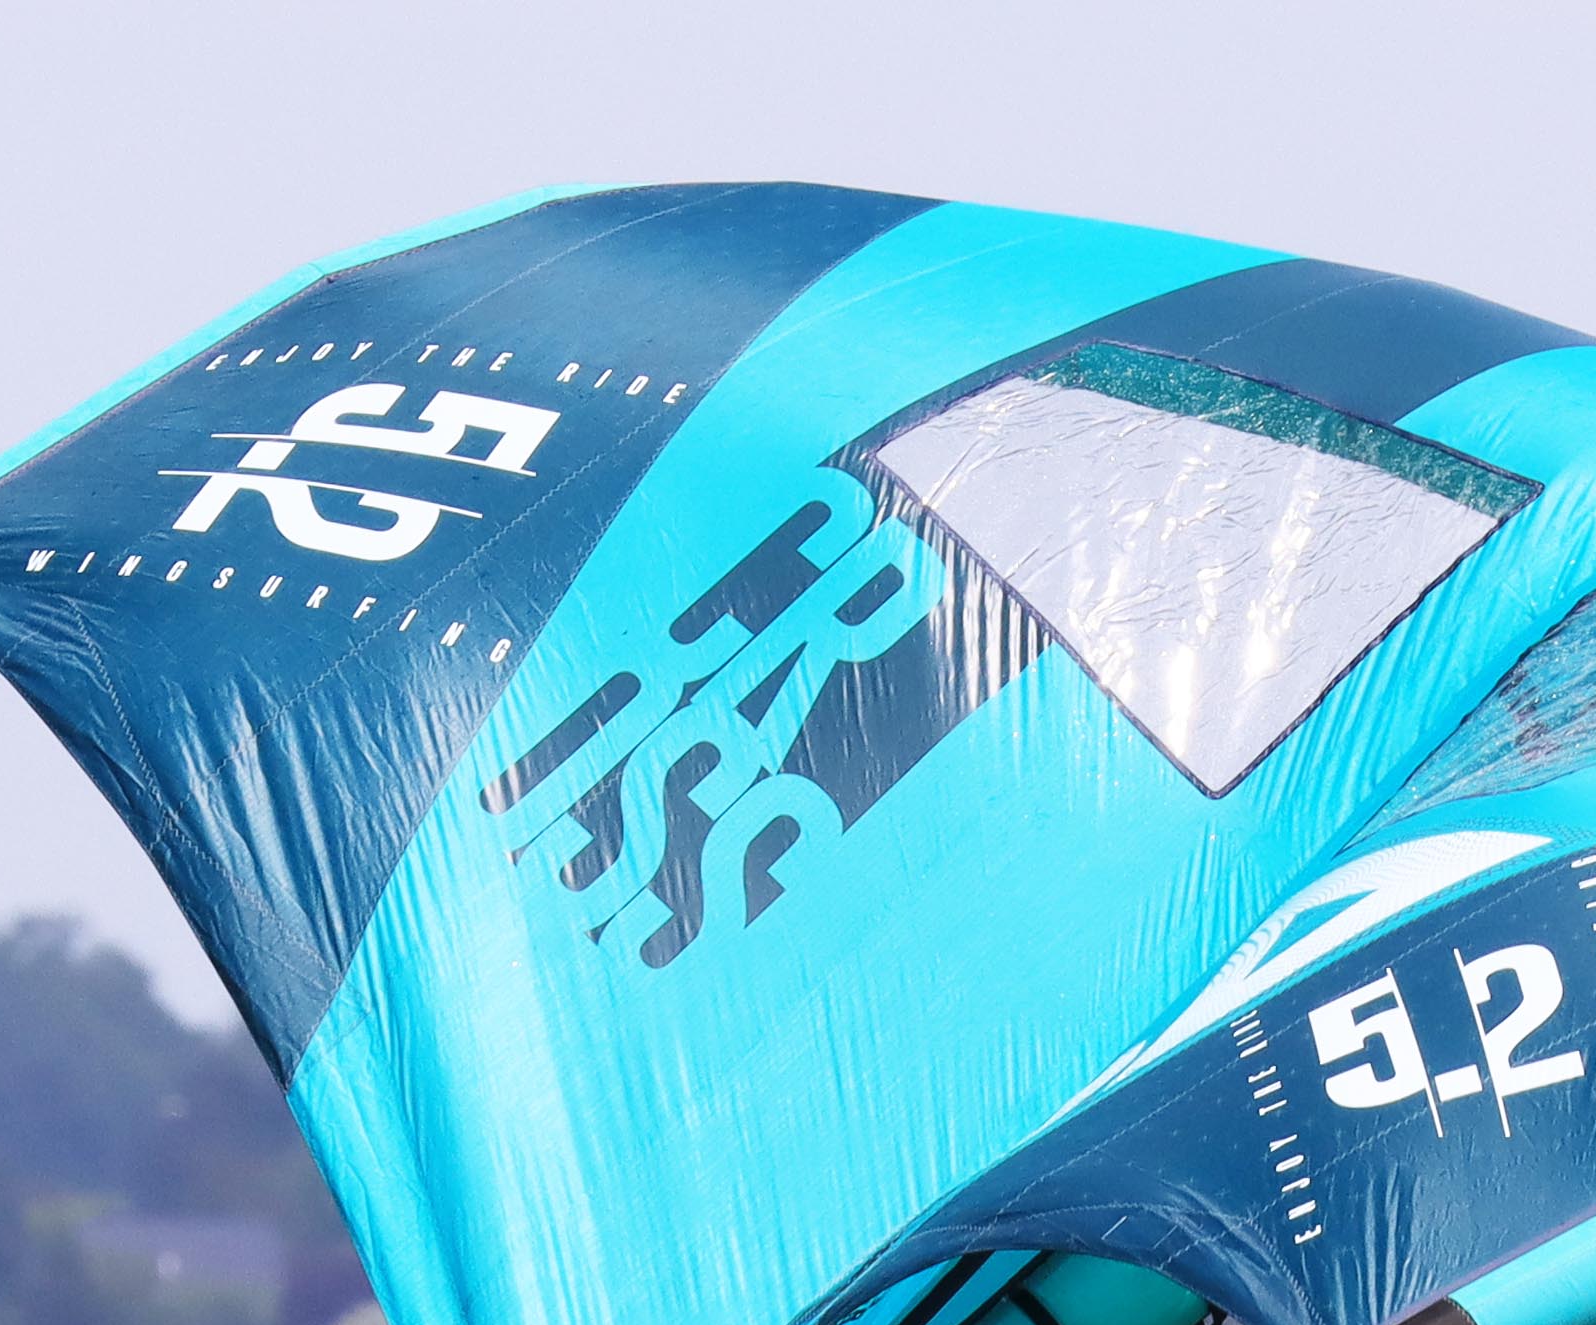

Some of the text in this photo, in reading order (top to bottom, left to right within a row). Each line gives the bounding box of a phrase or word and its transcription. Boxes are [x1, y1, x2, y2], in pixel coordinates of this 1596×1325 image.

[206, 341, 687, 404] ENJOY THE RIDE
[158, 383, 561, 562] 5.2
[25, 549, 512, 663] WINGSURFING
[1307, 943, 1586, 1110] 5.2
